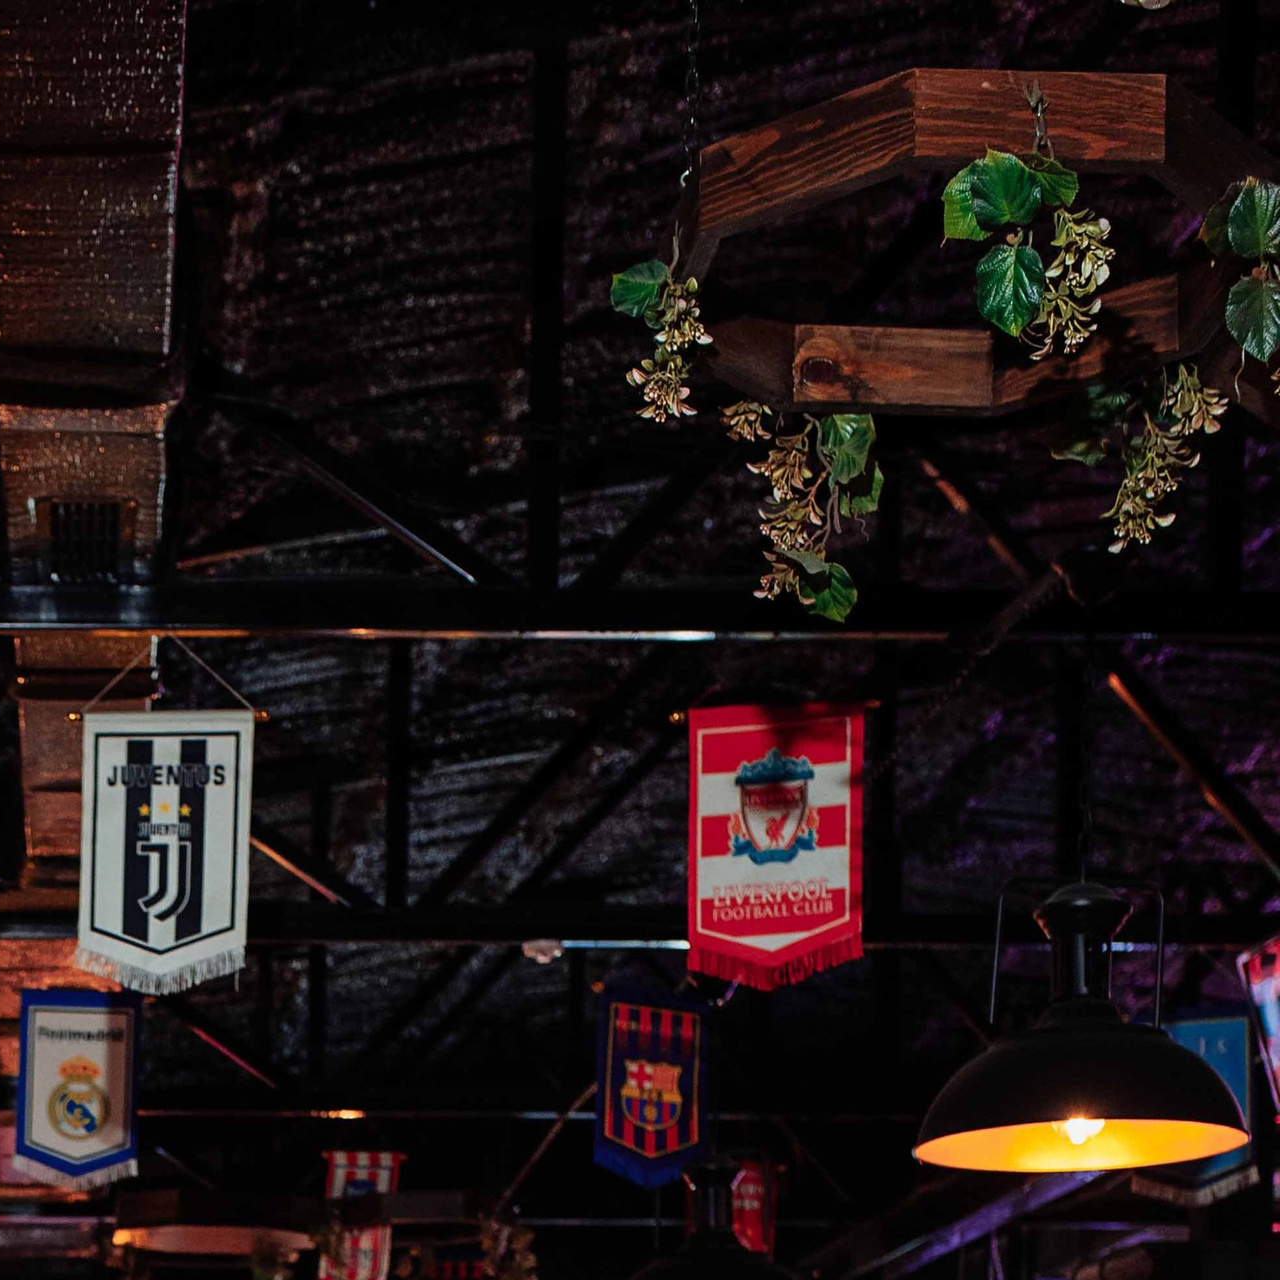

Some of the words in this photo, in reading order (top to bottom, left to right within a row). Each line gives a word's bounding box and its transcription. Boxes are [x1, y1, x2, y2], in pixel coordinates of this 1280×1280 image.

[107, 763, 227, 788] JUVENTUS
[712, 877, 833, 908] LIVERPOOL
[712, 902, 790, 922] FOOTBALL
[793, 898, 834, 916] CLUB
